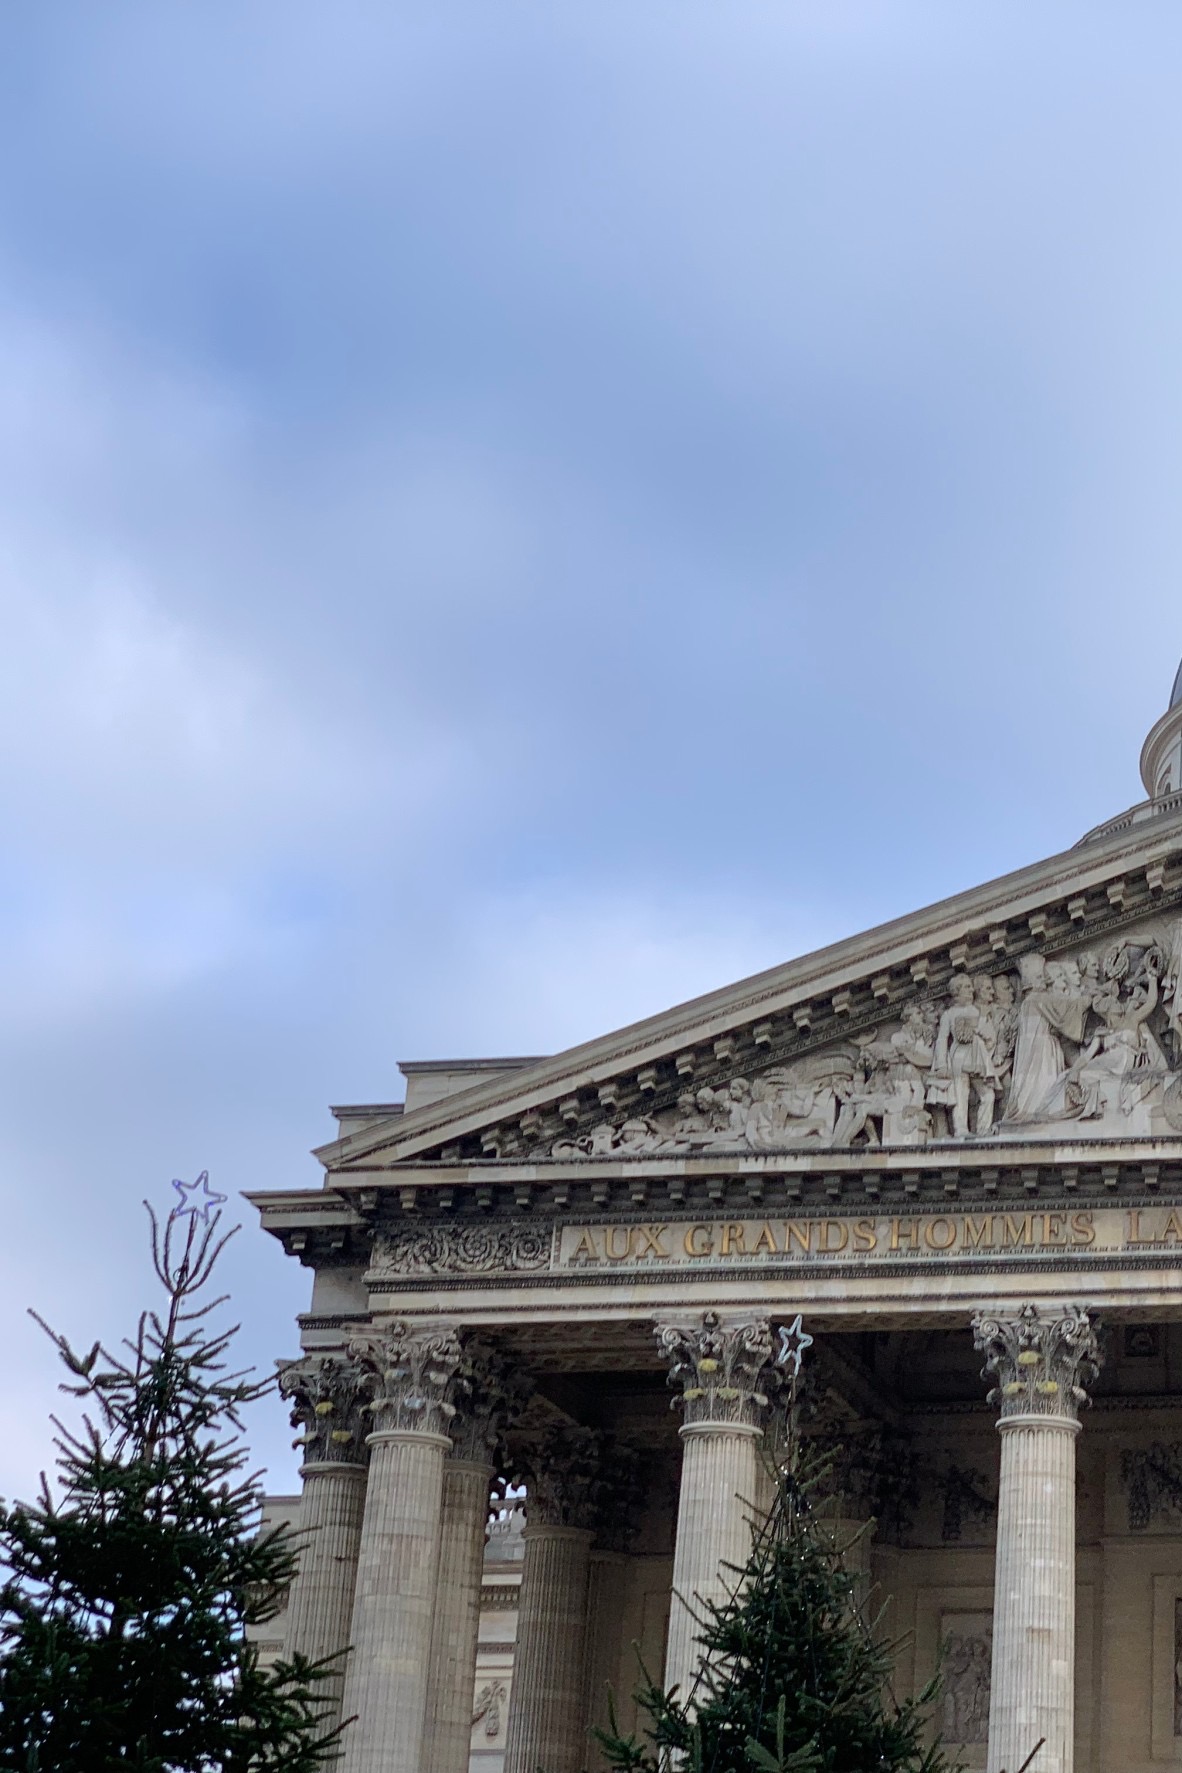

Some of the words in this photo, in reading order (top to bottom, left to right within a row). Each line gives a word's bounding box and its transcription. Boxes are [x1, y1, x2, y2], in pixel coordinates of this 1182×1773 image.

[568, 1222, 670, 1261] AUX
[684, 1217, 877, 1257] GRANDS
[889, 1211, 1097, 1252] HOMMES
